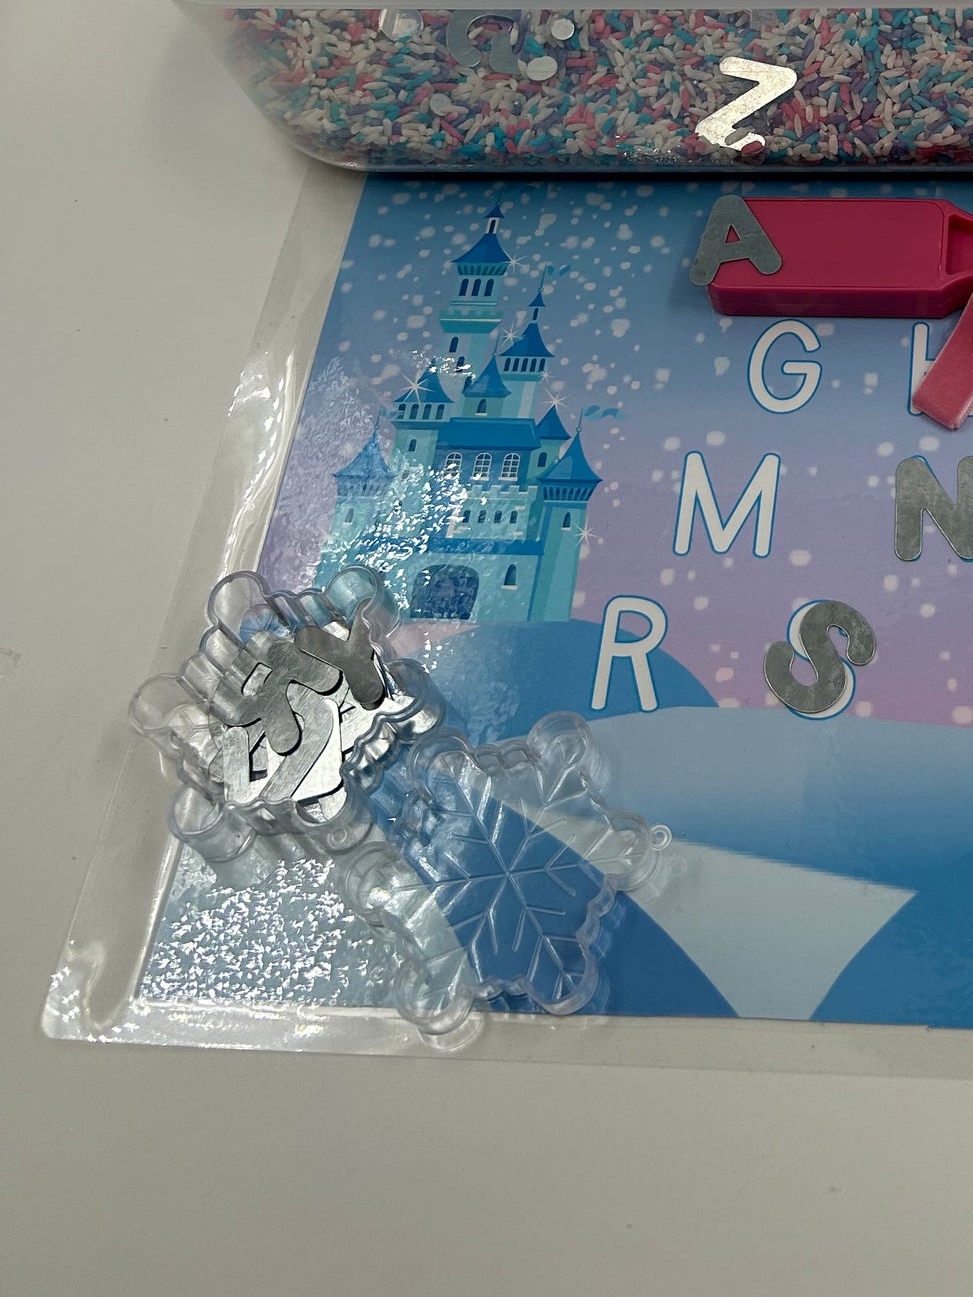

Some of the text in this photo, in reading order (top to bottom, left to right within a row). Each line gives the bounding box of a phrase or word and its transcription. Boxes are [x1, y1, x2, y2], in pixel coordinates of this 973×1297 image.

[694, 56, 798, 152] Z
[690, 194, 783, 286] A
[747, 318, 823, 415] G
[672, 451, 781, 557] M
[591, 594, 668, 713] R
[763, 599, 877, 720] S
